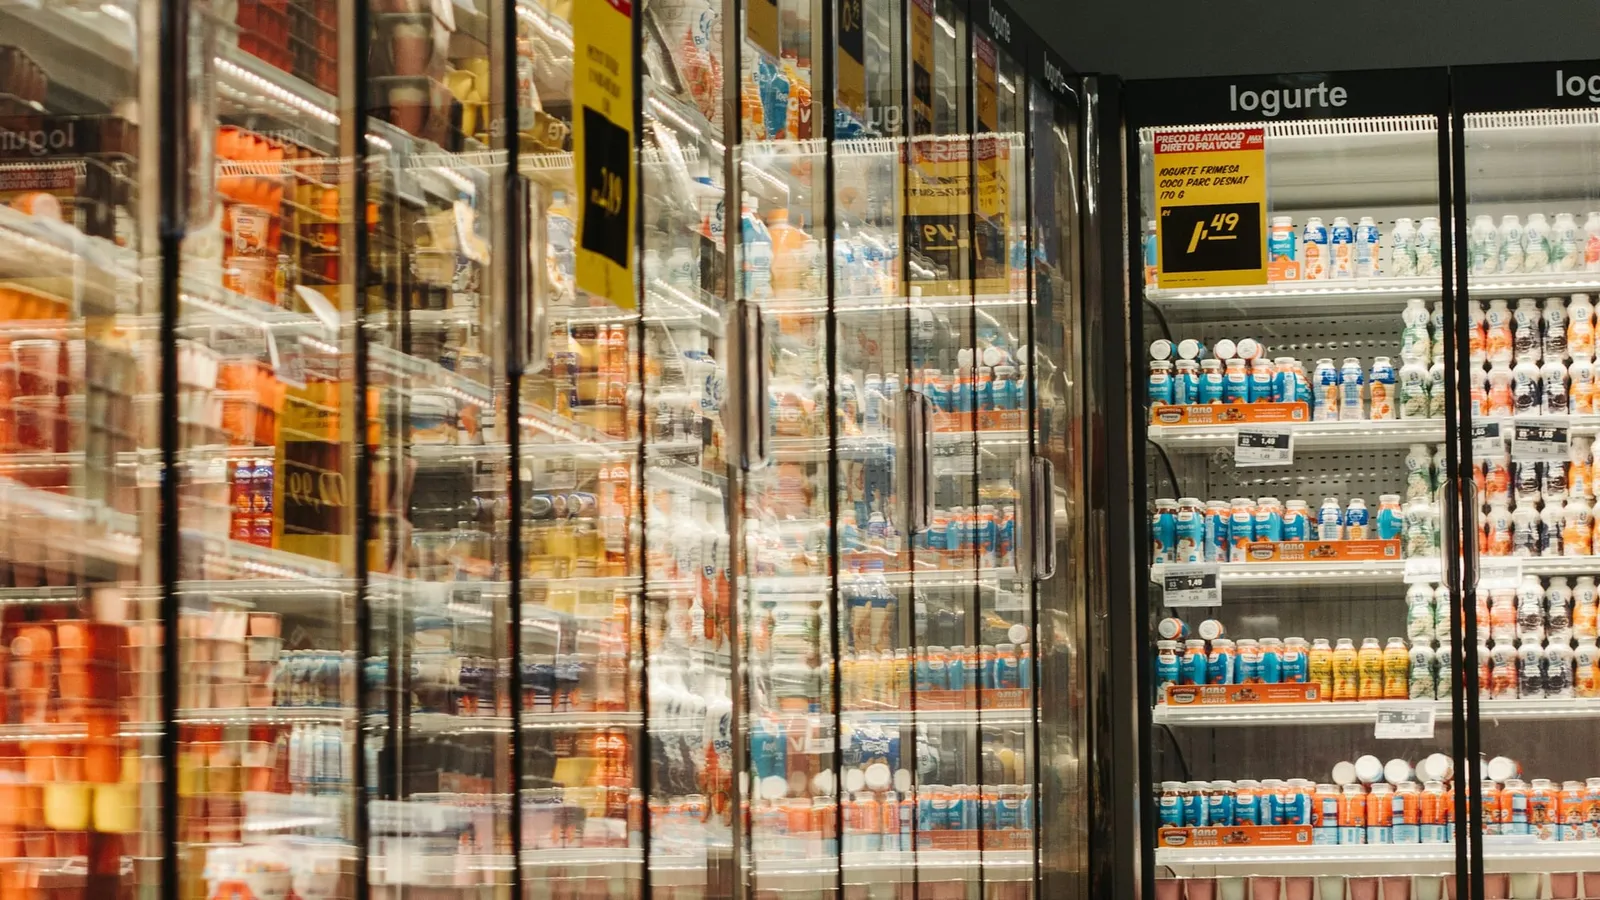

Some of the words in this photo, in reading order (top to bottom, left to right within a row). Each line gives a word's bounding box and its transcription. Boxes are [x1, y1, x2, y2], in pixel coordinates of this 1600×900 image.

[1230, 81, 1348, 117] Iogurte
[1188, 133, 1200, 143] DE
[1201, 132, 1245, 142] ATACADO
[1160, 143, 1195, 152] DIRETO
[1195, 142, 1215, 151] PRA
[1159, 166, 1198, 177] IOGURTE
[1200, 164, 1240, 175] FRIMESA
[1160, 179, 1184, 188] COCO
[1186, 178, 1210, 187] PARC
[1213, 176, 1249, 186] DESNAT
[1160, 191, 1176, 200] 170
[1178, 190, 1185, 199] G
